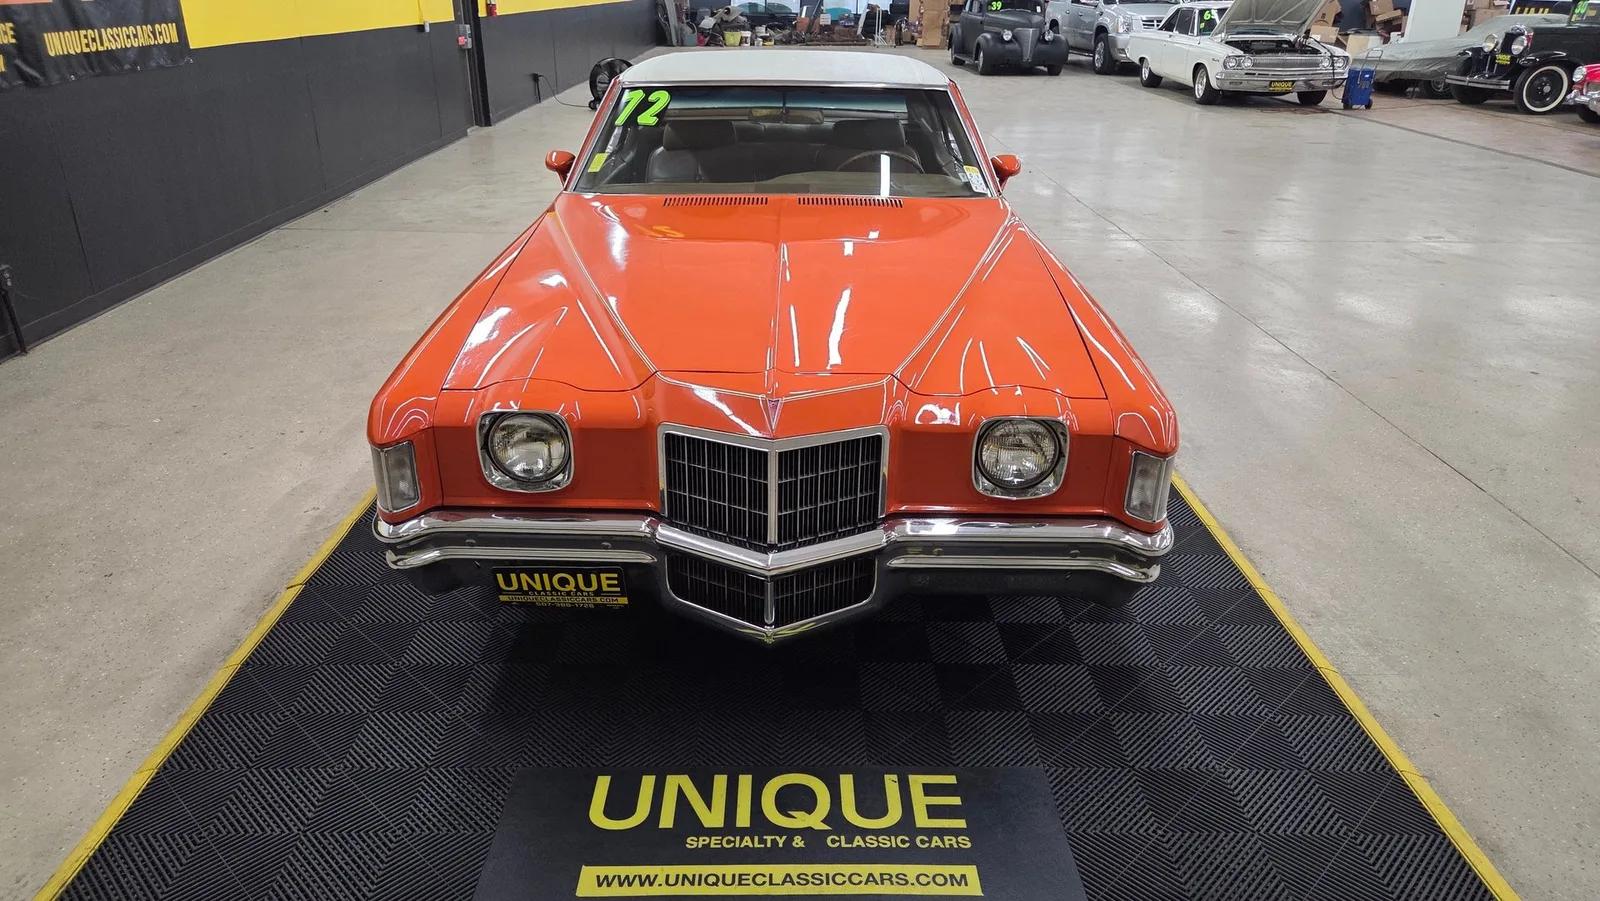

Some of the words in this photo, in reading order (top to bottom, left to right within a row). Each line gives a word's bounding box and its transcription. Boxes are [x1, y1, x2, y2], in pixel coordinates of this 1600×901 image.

[991, 1, 1001, 10] 39
[43, 23, 179, 56] UNIQUECLASSICCARS.COM
[615, 89, 671, 126] 72
[496, 573, 621, 591] UNIQUE
[588, 773, 967, 830] UNIQUE
[685, 835, 786, 849] SPECIALTY
[792, 835, 805, 849] &
[826, 835, 911, 849] CLASSIC
[915, 835, 972, 849] CARS
[595, 873, 969, 888] WWW.UNIQUECLASSICCARS.COM
